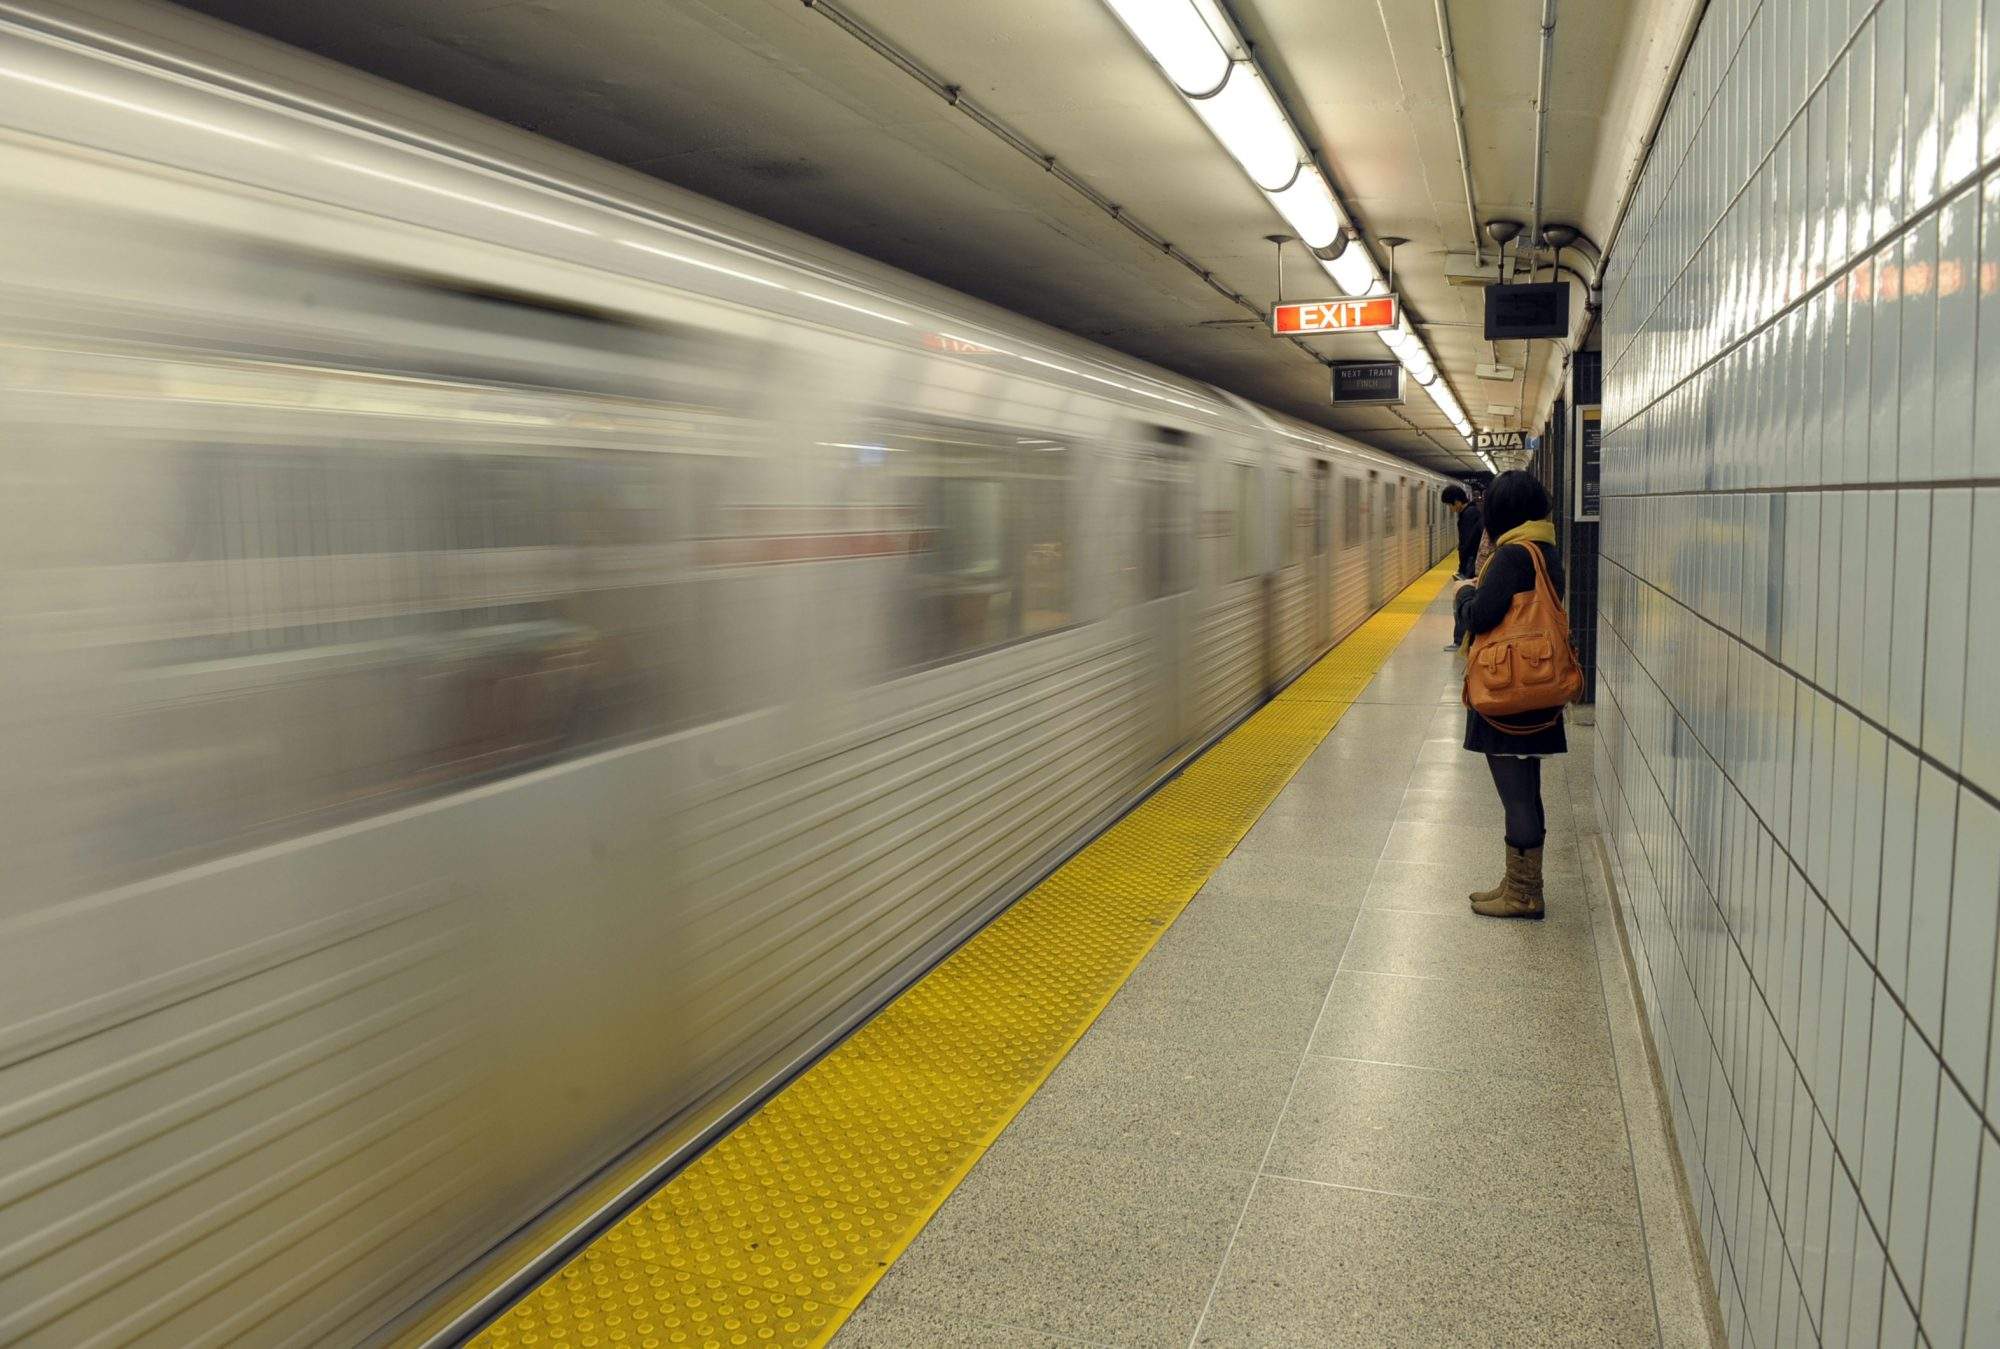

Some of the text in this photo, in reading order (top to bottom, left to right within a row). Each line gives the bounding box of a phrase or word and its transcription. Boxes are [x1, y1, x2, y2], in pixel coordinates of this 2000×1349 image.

[1300, 302, 1368, 330] EXIT
[1341, 368, 1393, 378] NEXT TRAIN
[1477, 433, 1523, 448] DWA
